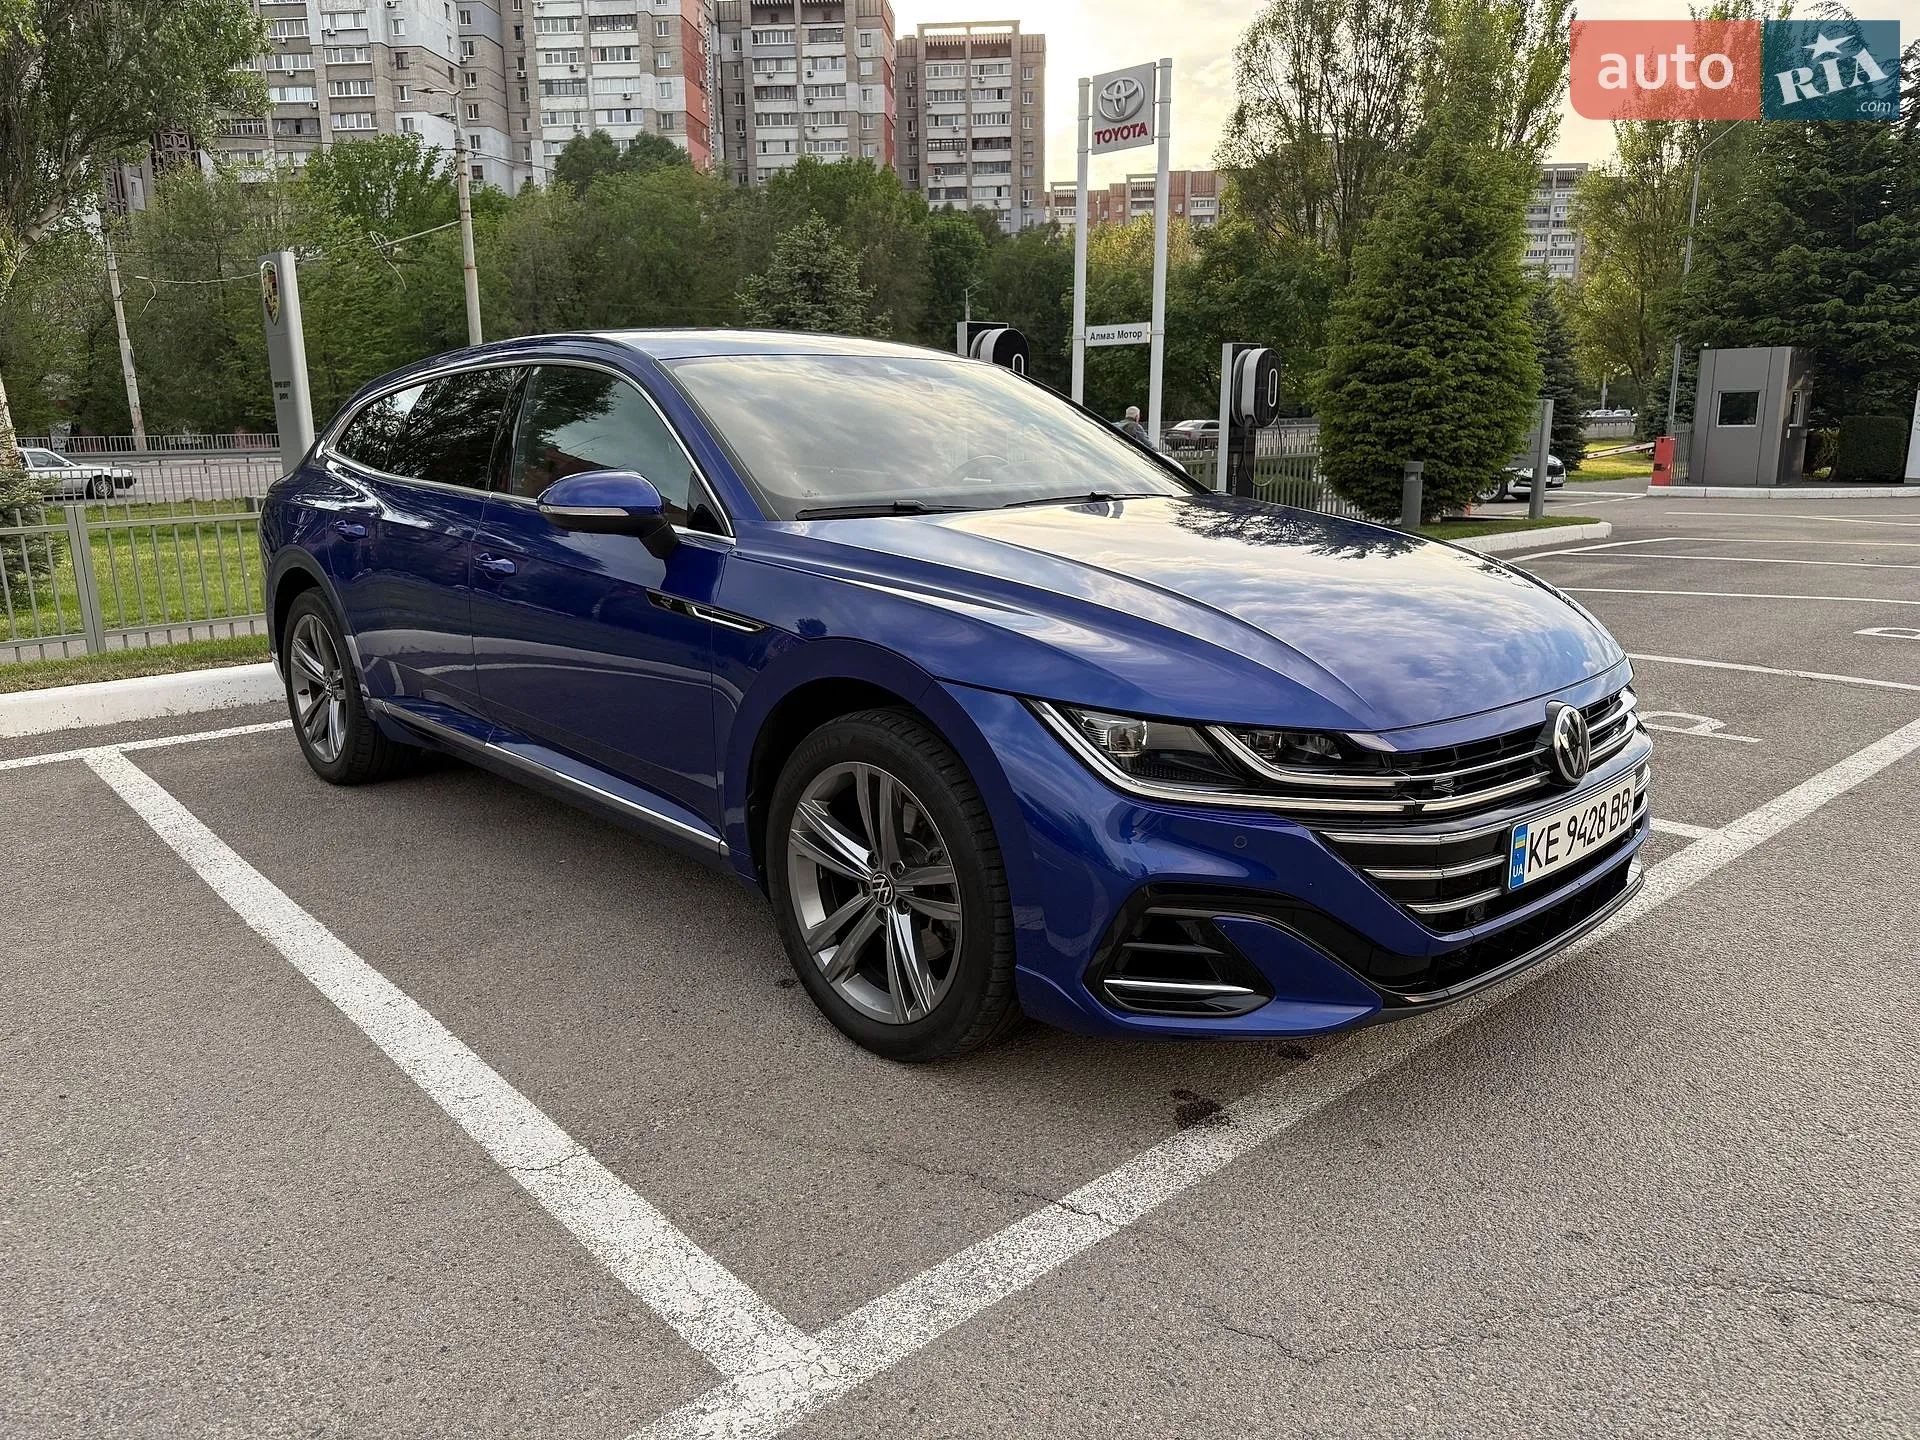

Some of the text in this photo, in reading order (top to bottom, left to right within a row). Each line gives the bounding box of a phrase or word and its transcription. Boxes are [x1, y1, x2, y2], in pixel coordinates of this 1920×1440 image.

[1094, 121, 1148, 145] TOYOTA
[1090, 330, 1143, 341] Алмаз Мотор
[1527, 787, 1631, 873] KE 9428 BB
[1512, 863, 1524, 878] UA
